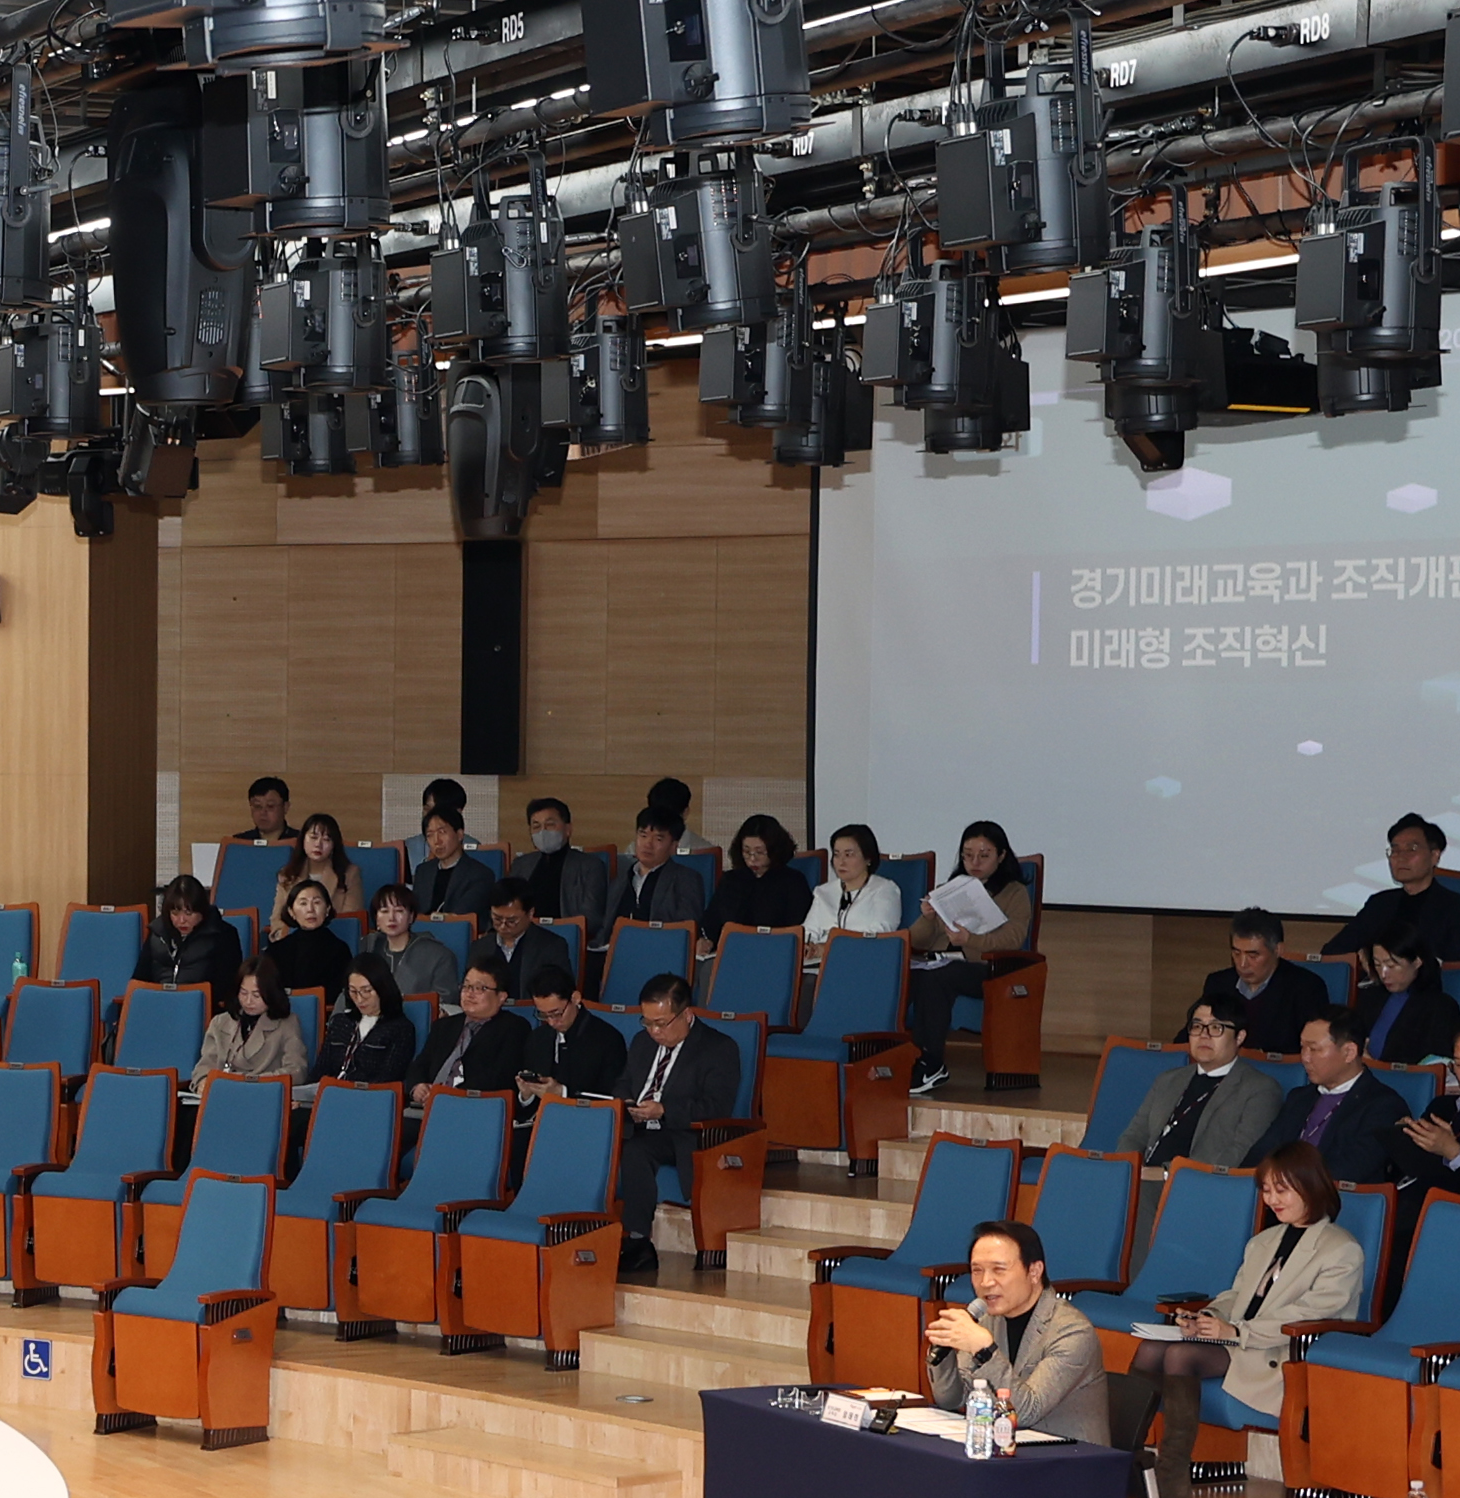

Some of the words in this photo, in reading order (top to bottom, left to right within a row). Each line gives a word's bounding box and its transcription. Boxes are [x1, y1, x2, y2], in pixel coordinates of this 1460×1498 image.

[501, 11, 524, 43] RD5
[1299, 16, 1330, 45] RD8
[1110, 59, 1137, 89] RD7
[1070, 561, 1323, 609] 경기미래교육과
[1069, 627, 1172, 670] 미래형
[1181, 624, 1327, 668] 조직혁신
